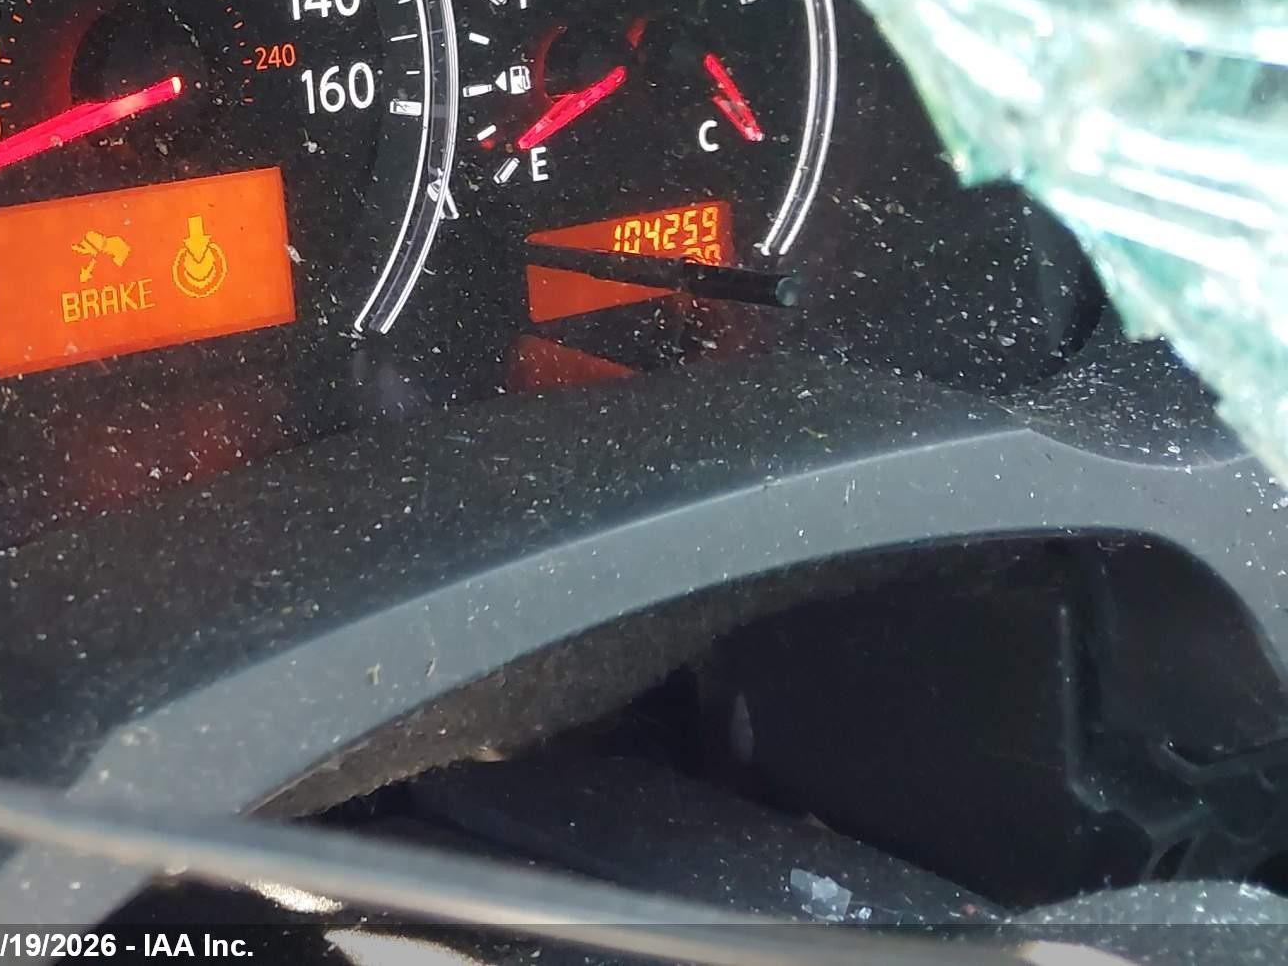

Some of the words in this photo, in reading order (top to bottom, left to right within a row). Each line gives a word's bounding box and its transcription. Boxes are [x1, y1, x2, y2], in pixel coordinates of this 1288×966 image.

[254, 43, 296, 70] 240
[301, 61, 375, 115] 160
[698, 119, 719, 152] C
[530, 146, 549, 182] E
[613, 206, 719, 254] 104259
[61, 279, 153, 323] BRAKE
